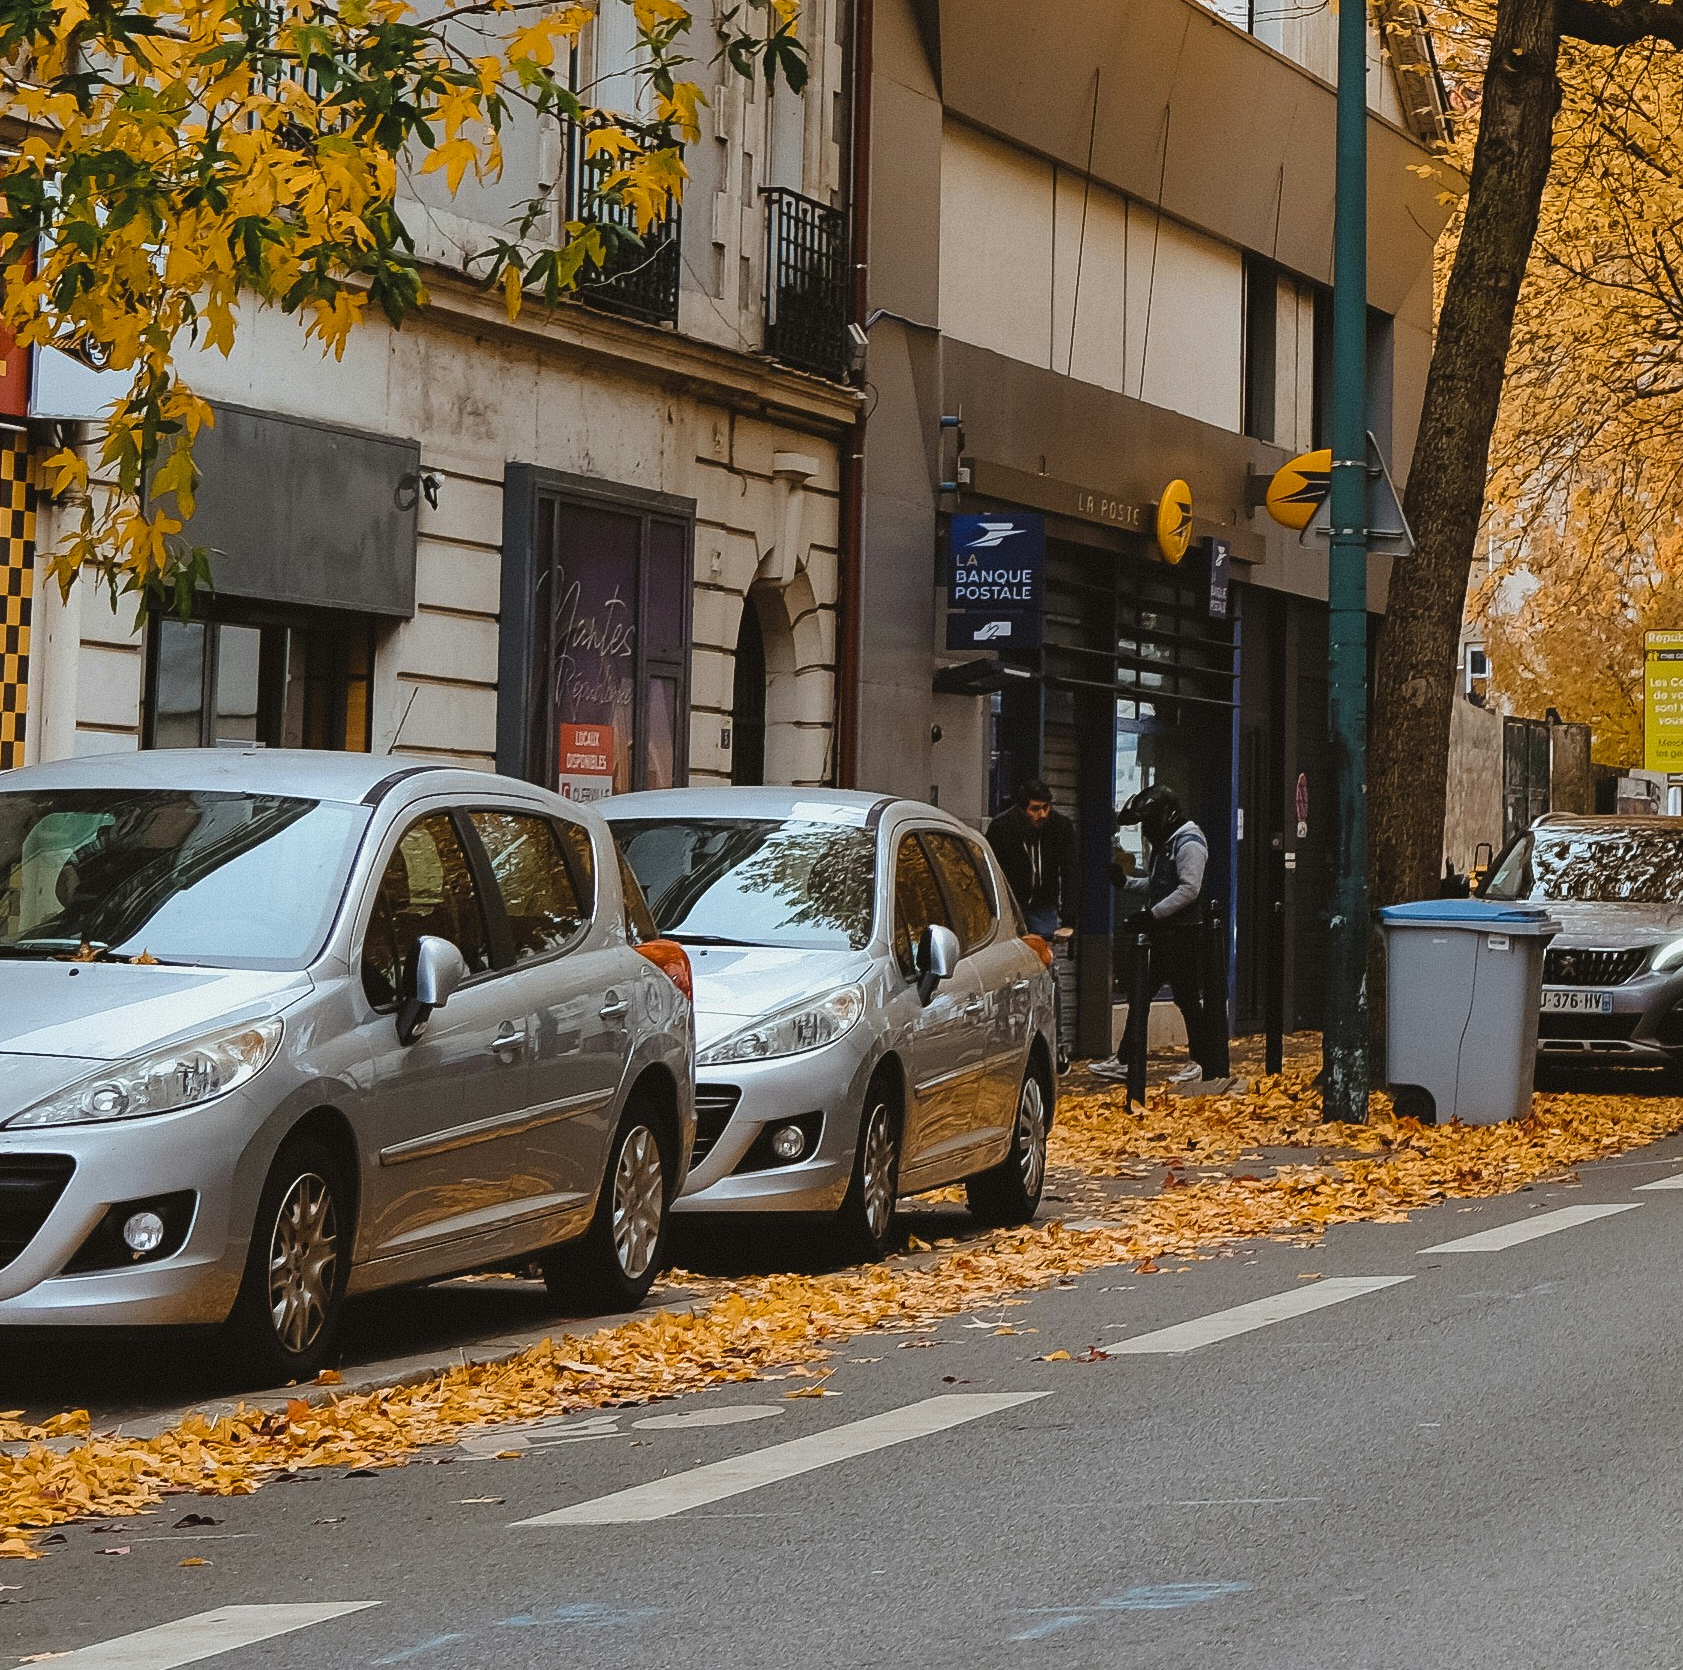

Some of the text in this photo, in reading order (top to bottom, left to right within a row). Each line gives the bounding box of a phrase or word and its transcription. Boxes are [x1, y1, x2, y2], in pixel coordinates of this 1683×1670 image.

[1078, 492, 1140, 526] LA POSTE
[956, 553, 978, 567] LA
[956, 570, 1032, 585] BANQUE
[955, 586, 1032, 600] POSTALE
[1540, 992, 1602, 1009] J-376-HV
